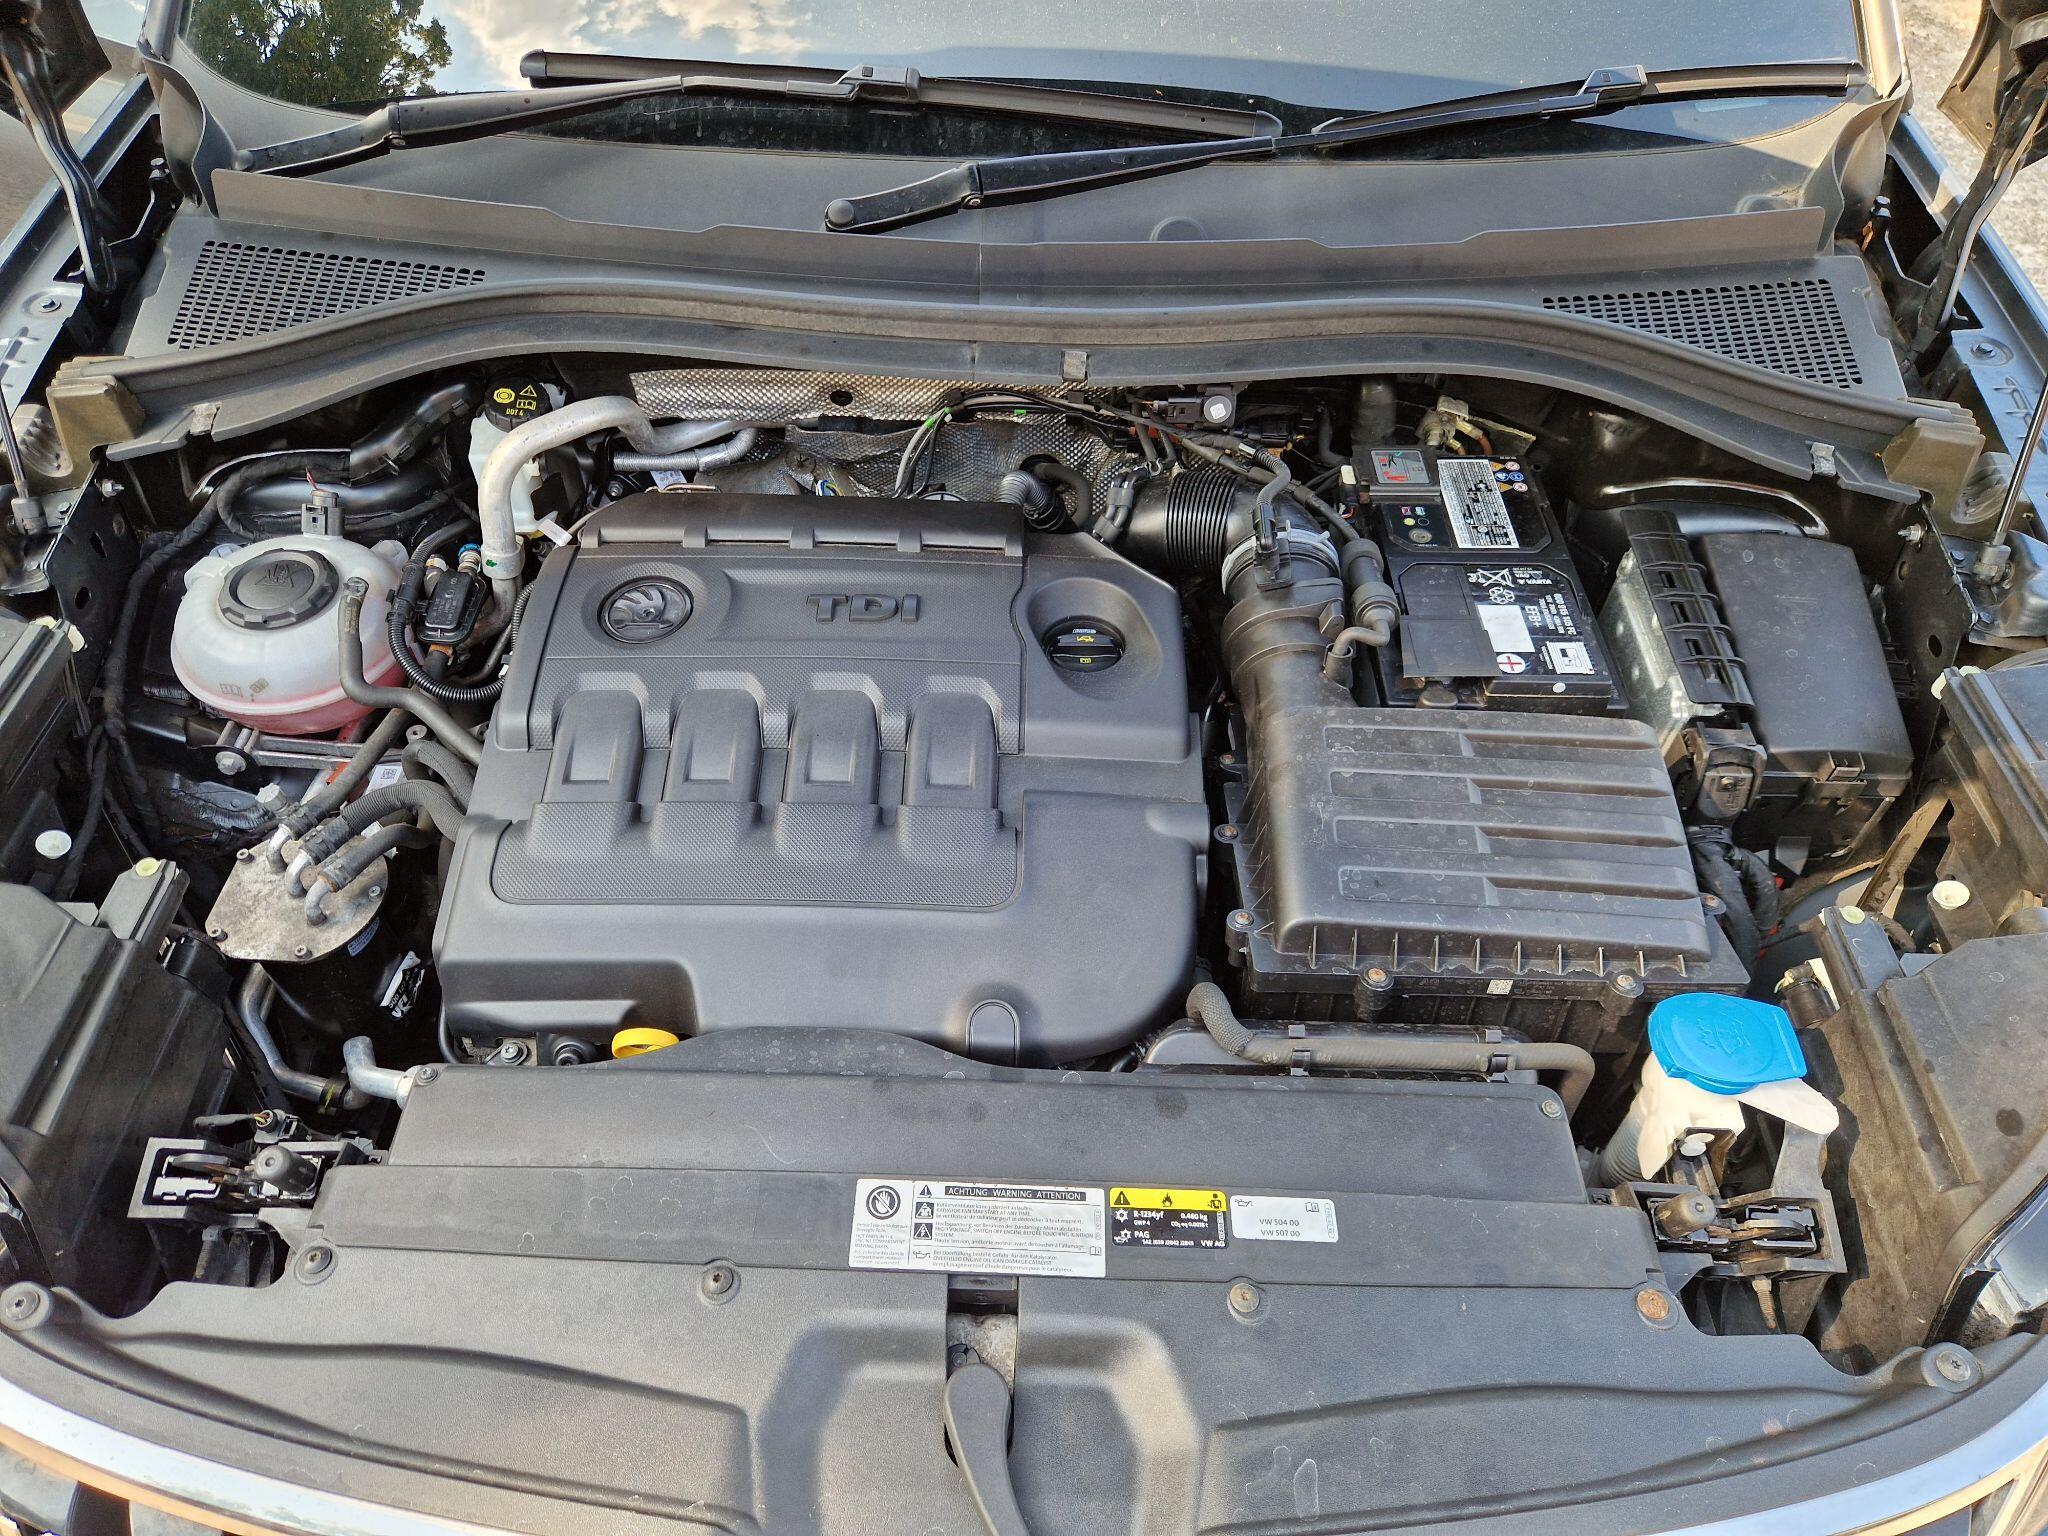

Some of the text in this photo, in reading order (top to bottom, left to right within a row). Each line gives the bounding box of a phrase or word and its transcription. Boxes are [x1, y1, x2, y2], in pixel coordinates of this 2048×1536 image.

[806, 594, 919, 622] TDI
[1525, 606, 1542, 628] EFB+
[948, 1187, 1080, 1200] ACHTUNG WARNING ATTENTION
[1134, 1210, 1164, 1220] R-1234yf
